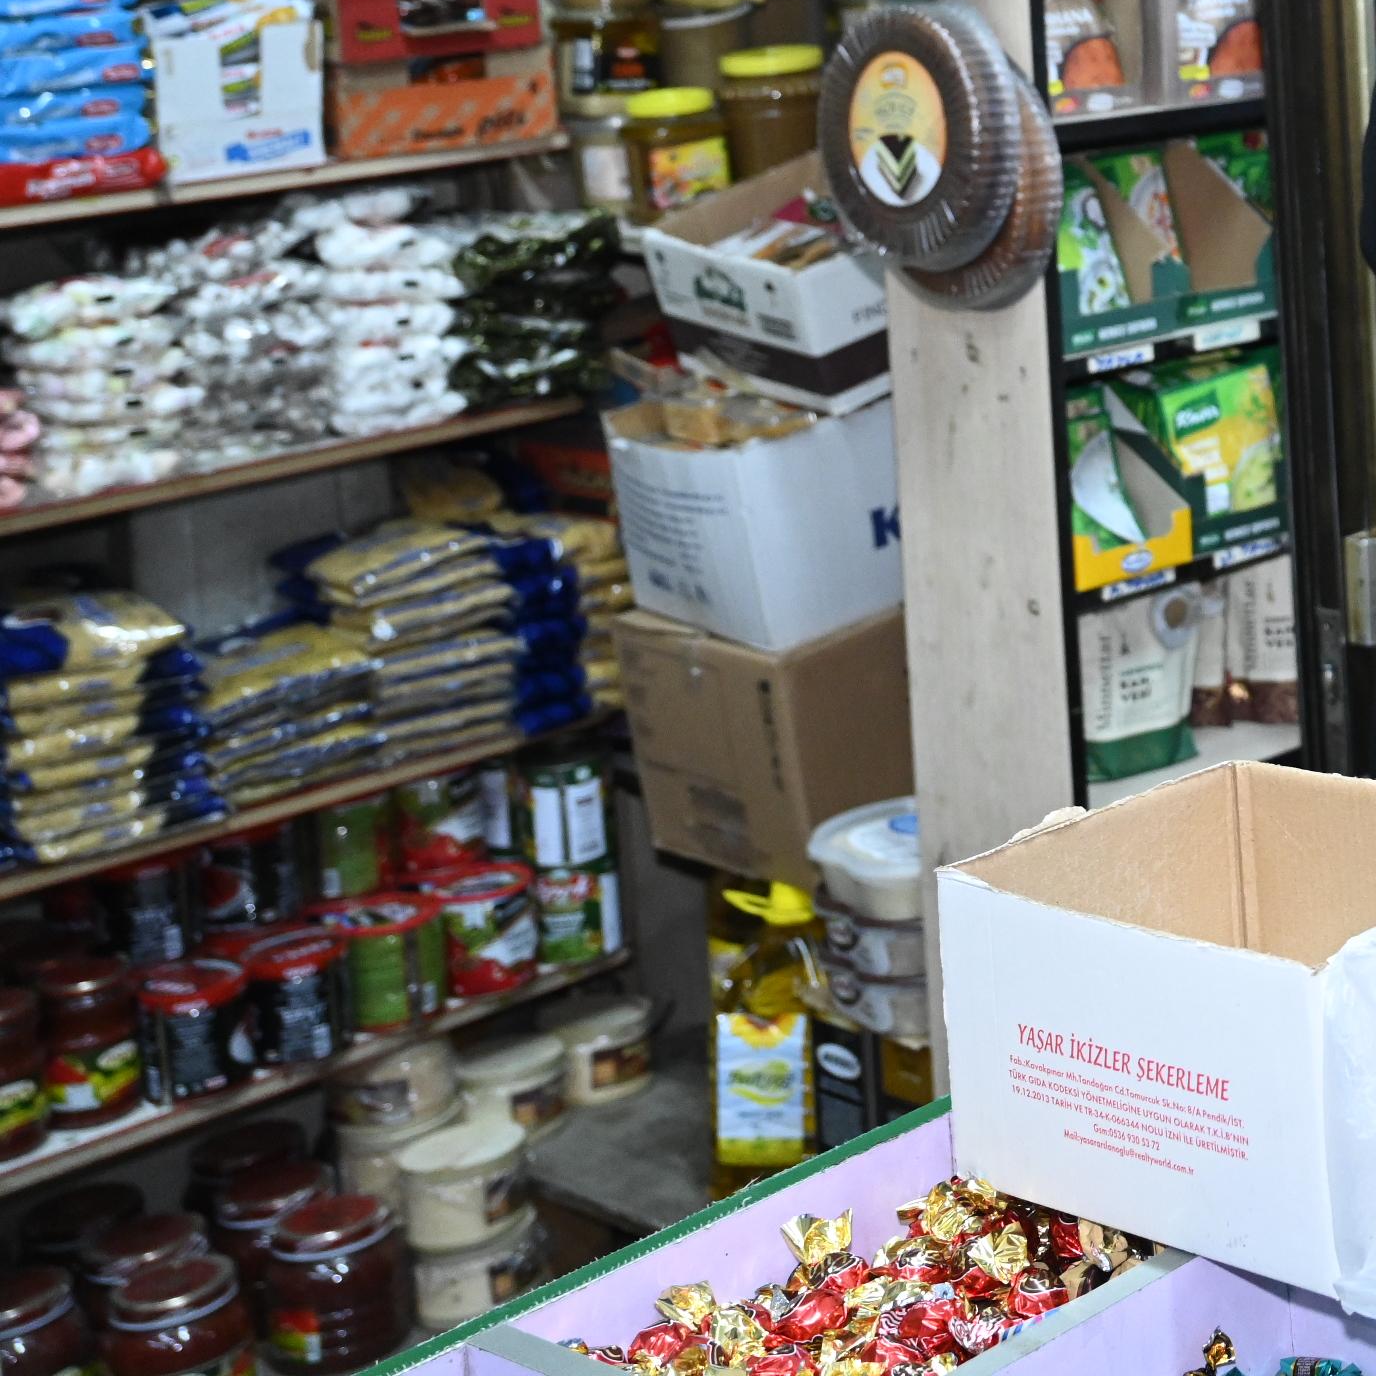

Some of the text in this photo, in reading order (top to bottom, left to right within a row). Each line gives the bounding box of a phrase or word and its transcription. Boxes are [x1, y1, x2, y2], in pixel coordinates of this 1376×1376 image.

[1017, 1023, 1230, 1101] YAŞAR İKİZLER ŞEKERLEME
[1009, 1069, 1027, 1082] TÜRK
[1028, 1075, 1047, 1088] GIDA
[1048, 1080, 1080, 1098] KODEKSİ
[1142, 1108, 1172, 1125] UYGUN
[1173, 1117, 1206, 1135] OLARAK
[1012, 1084, 1050, 1104] 19.12.2013
[1051, 1096, 1073, 1111] TARİH
[1074, 1103, 1083, 1114] VE
[1141, 1123, 1164, 1137] NOLU
[1093, 1123, 1161, 1151] Gsm:0536 930 53 72
